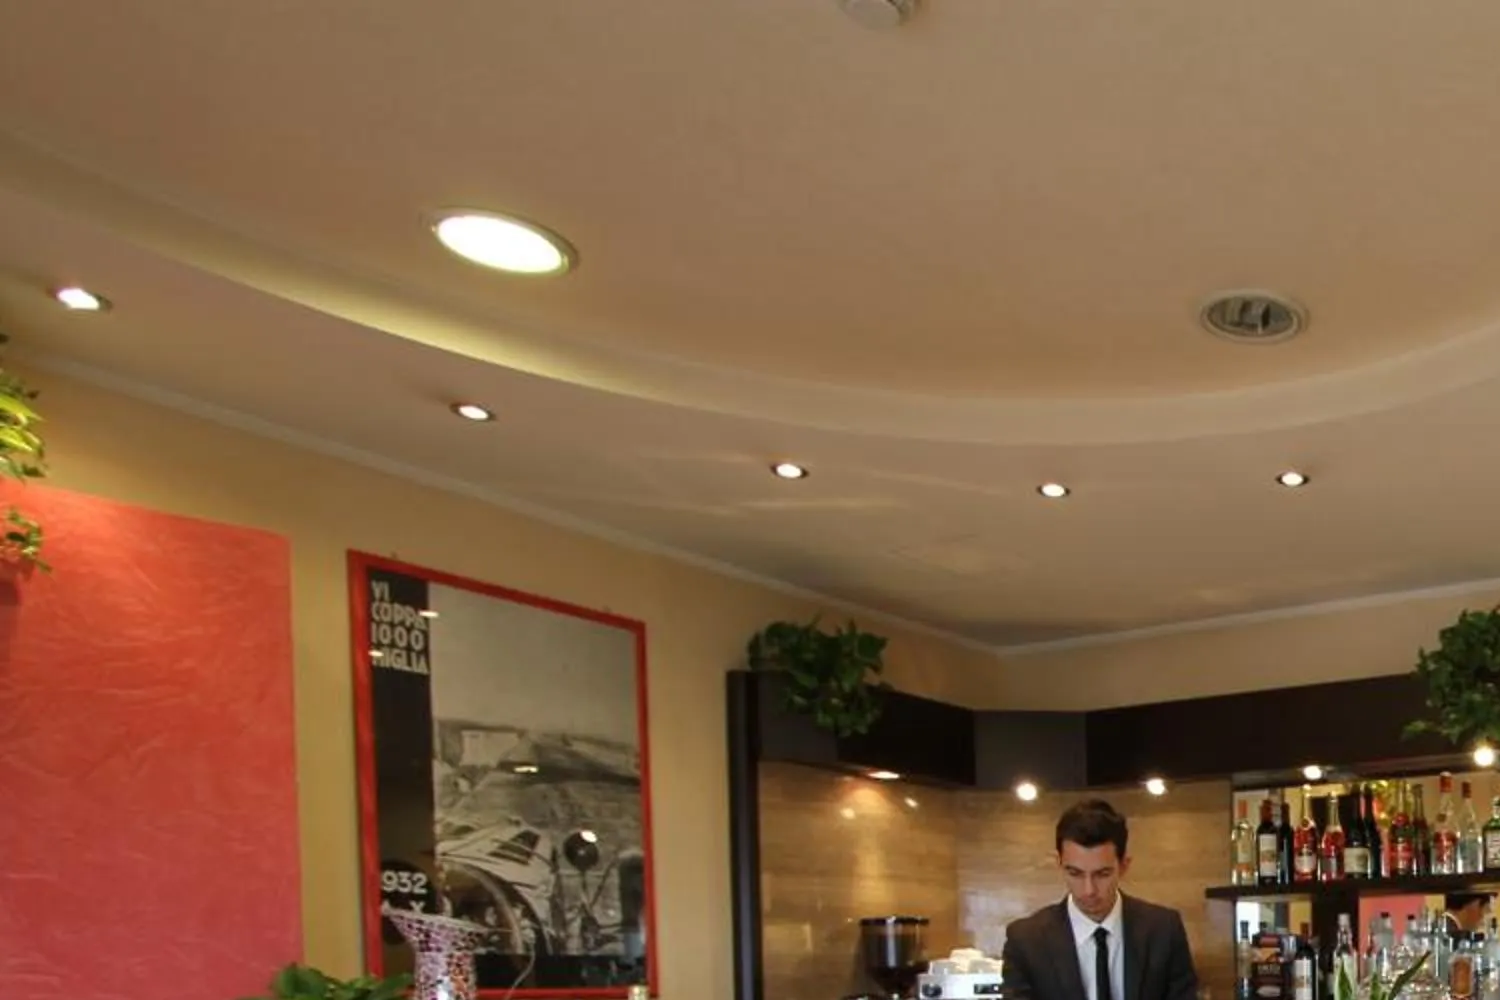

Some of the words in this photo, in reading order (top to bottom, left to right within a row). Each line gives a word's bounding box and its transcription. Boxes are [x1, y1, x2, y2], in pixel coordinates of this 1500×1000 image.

[372, 580, 389, 601] VI
[372, 601, 428, 629] COPPA
[372, 622, 424, 651] 1000
[372, 645, 430, 674] MIGLIA
